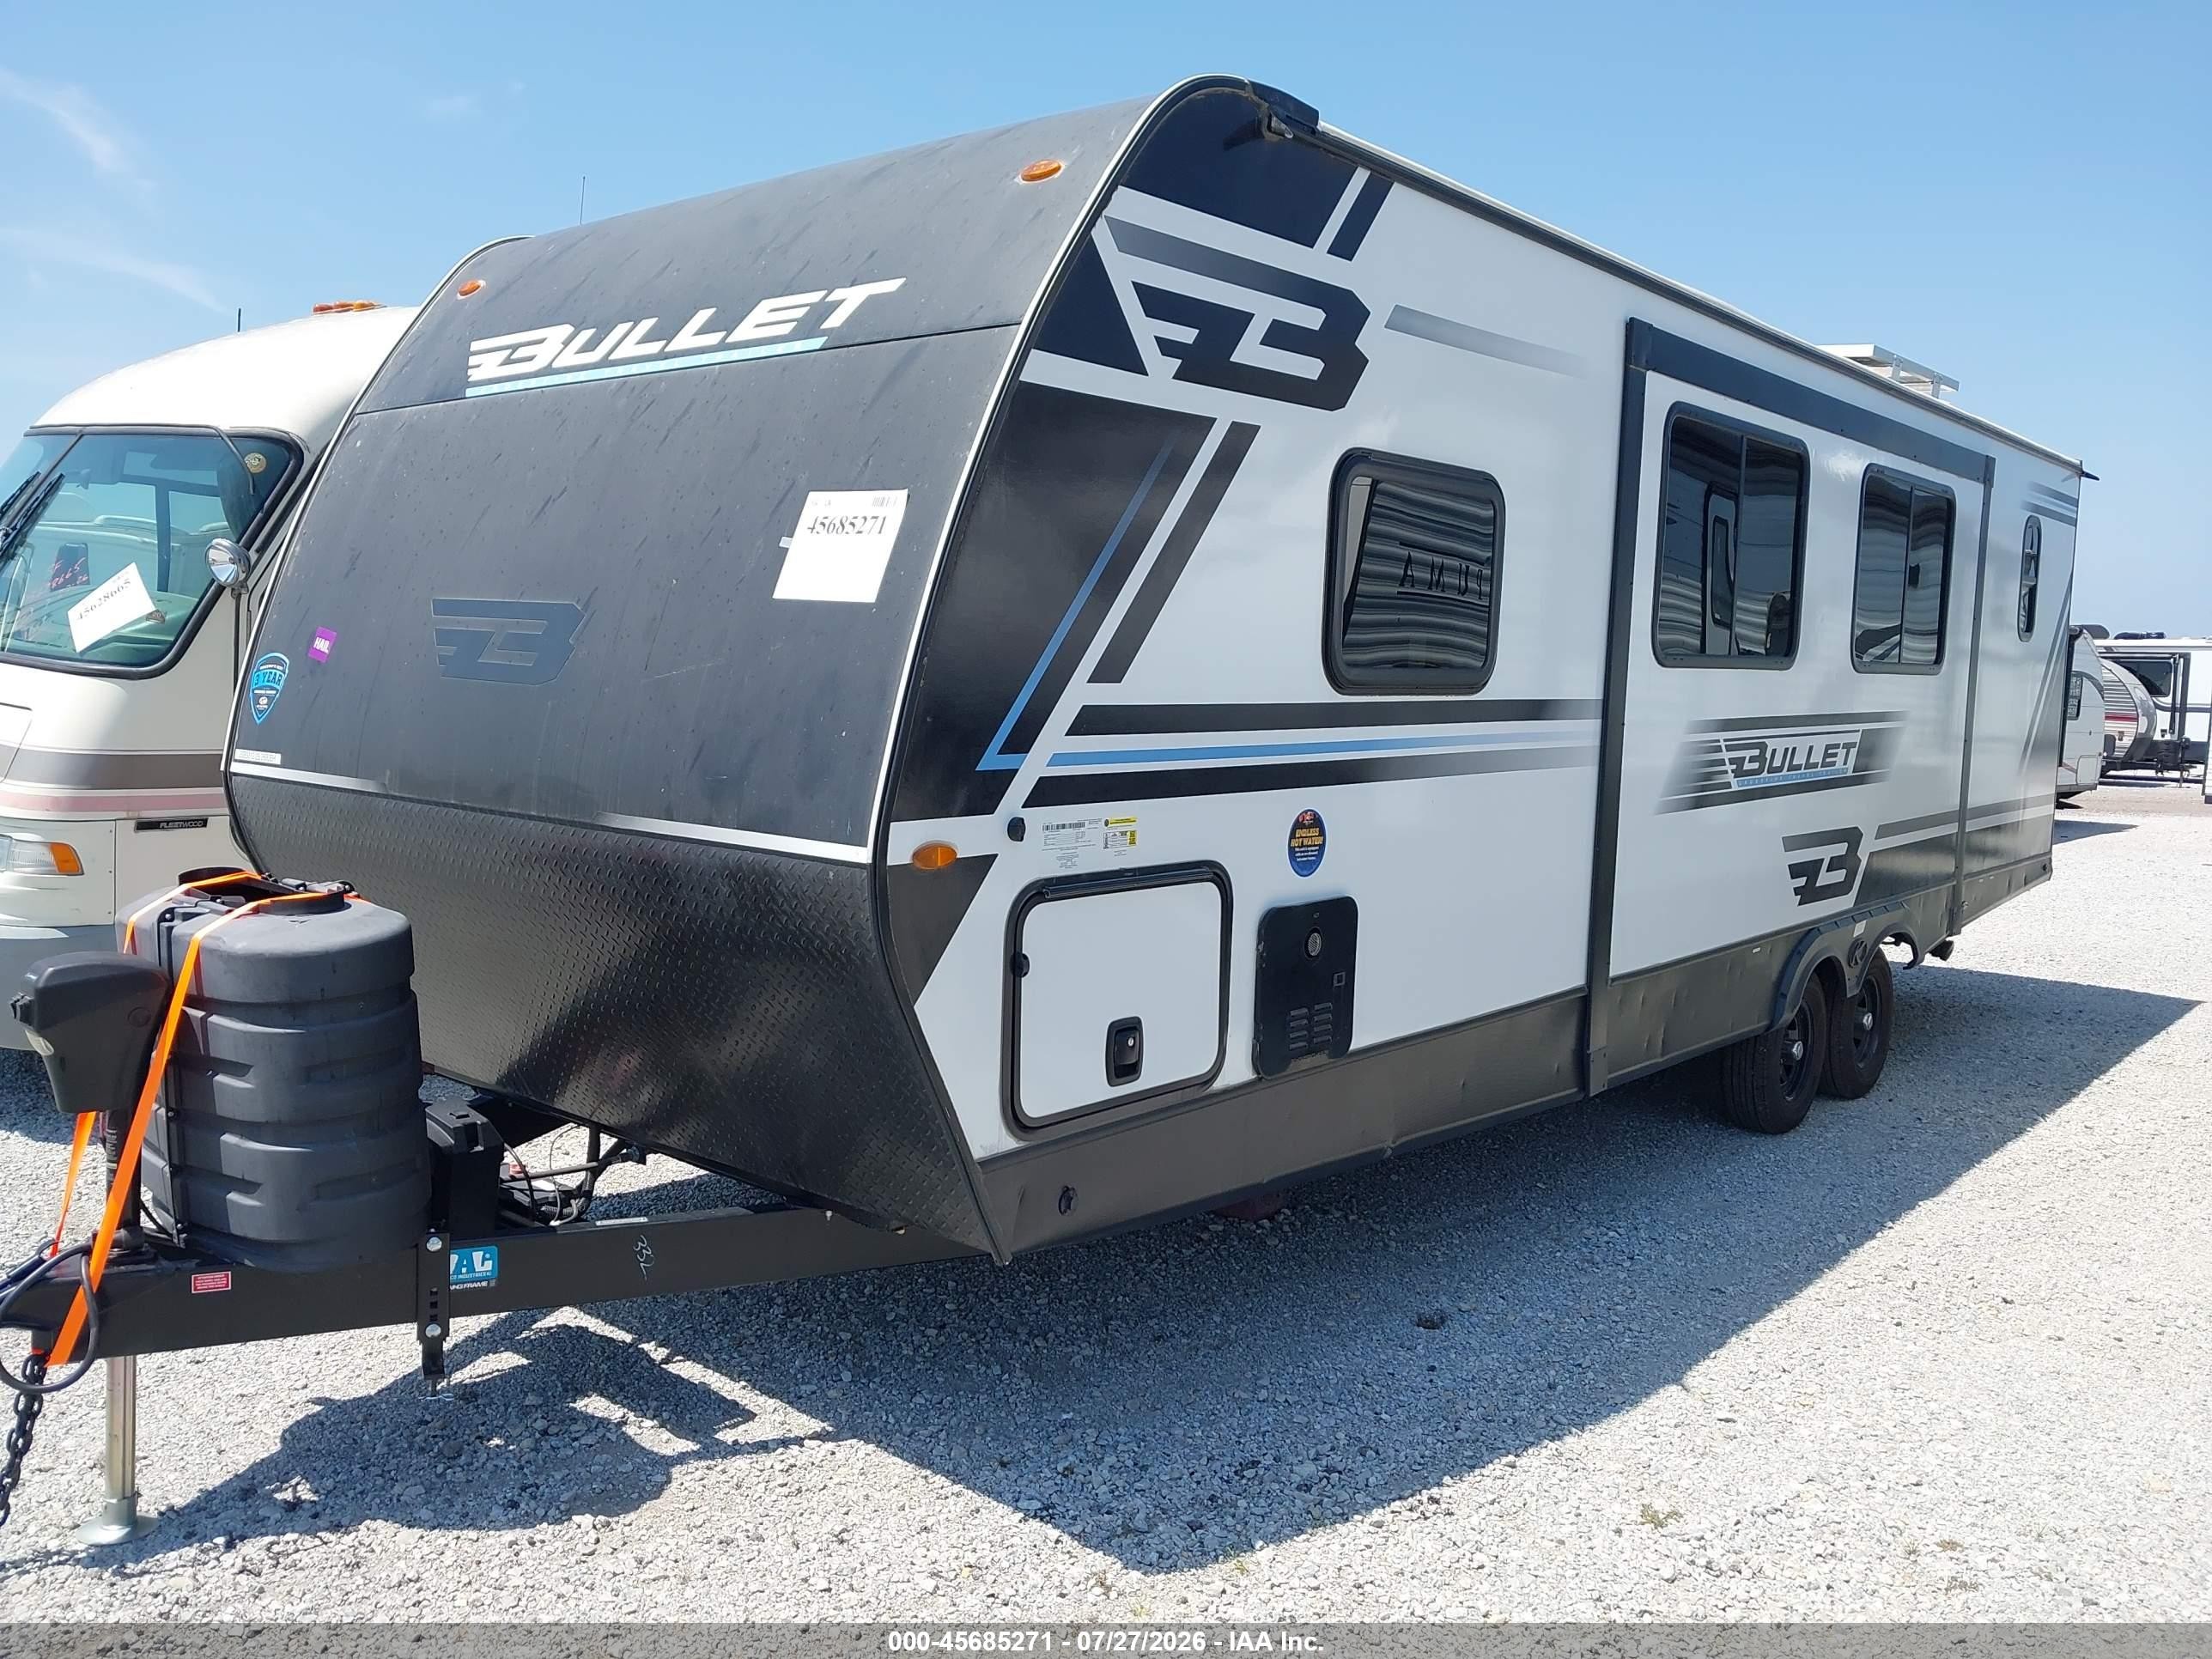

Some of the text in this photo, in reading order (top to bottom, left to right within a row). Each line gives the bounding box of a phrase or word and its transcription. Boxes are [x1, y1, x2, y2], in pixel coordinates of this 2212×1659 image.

[466, 276, 907, 382] BULLET
[806, 515, 887, 535] 45685271
[76, 577, 132, 622] 45628665
[313, 636, 331, 654] HAIL
[262, 671, 283, 686] YEAR
[1724, 740, 1858, 779] BULLET
[159, 821, 204, 830] FLEETWOOD
[1296, 828, 1319, 837] ENDLESS
